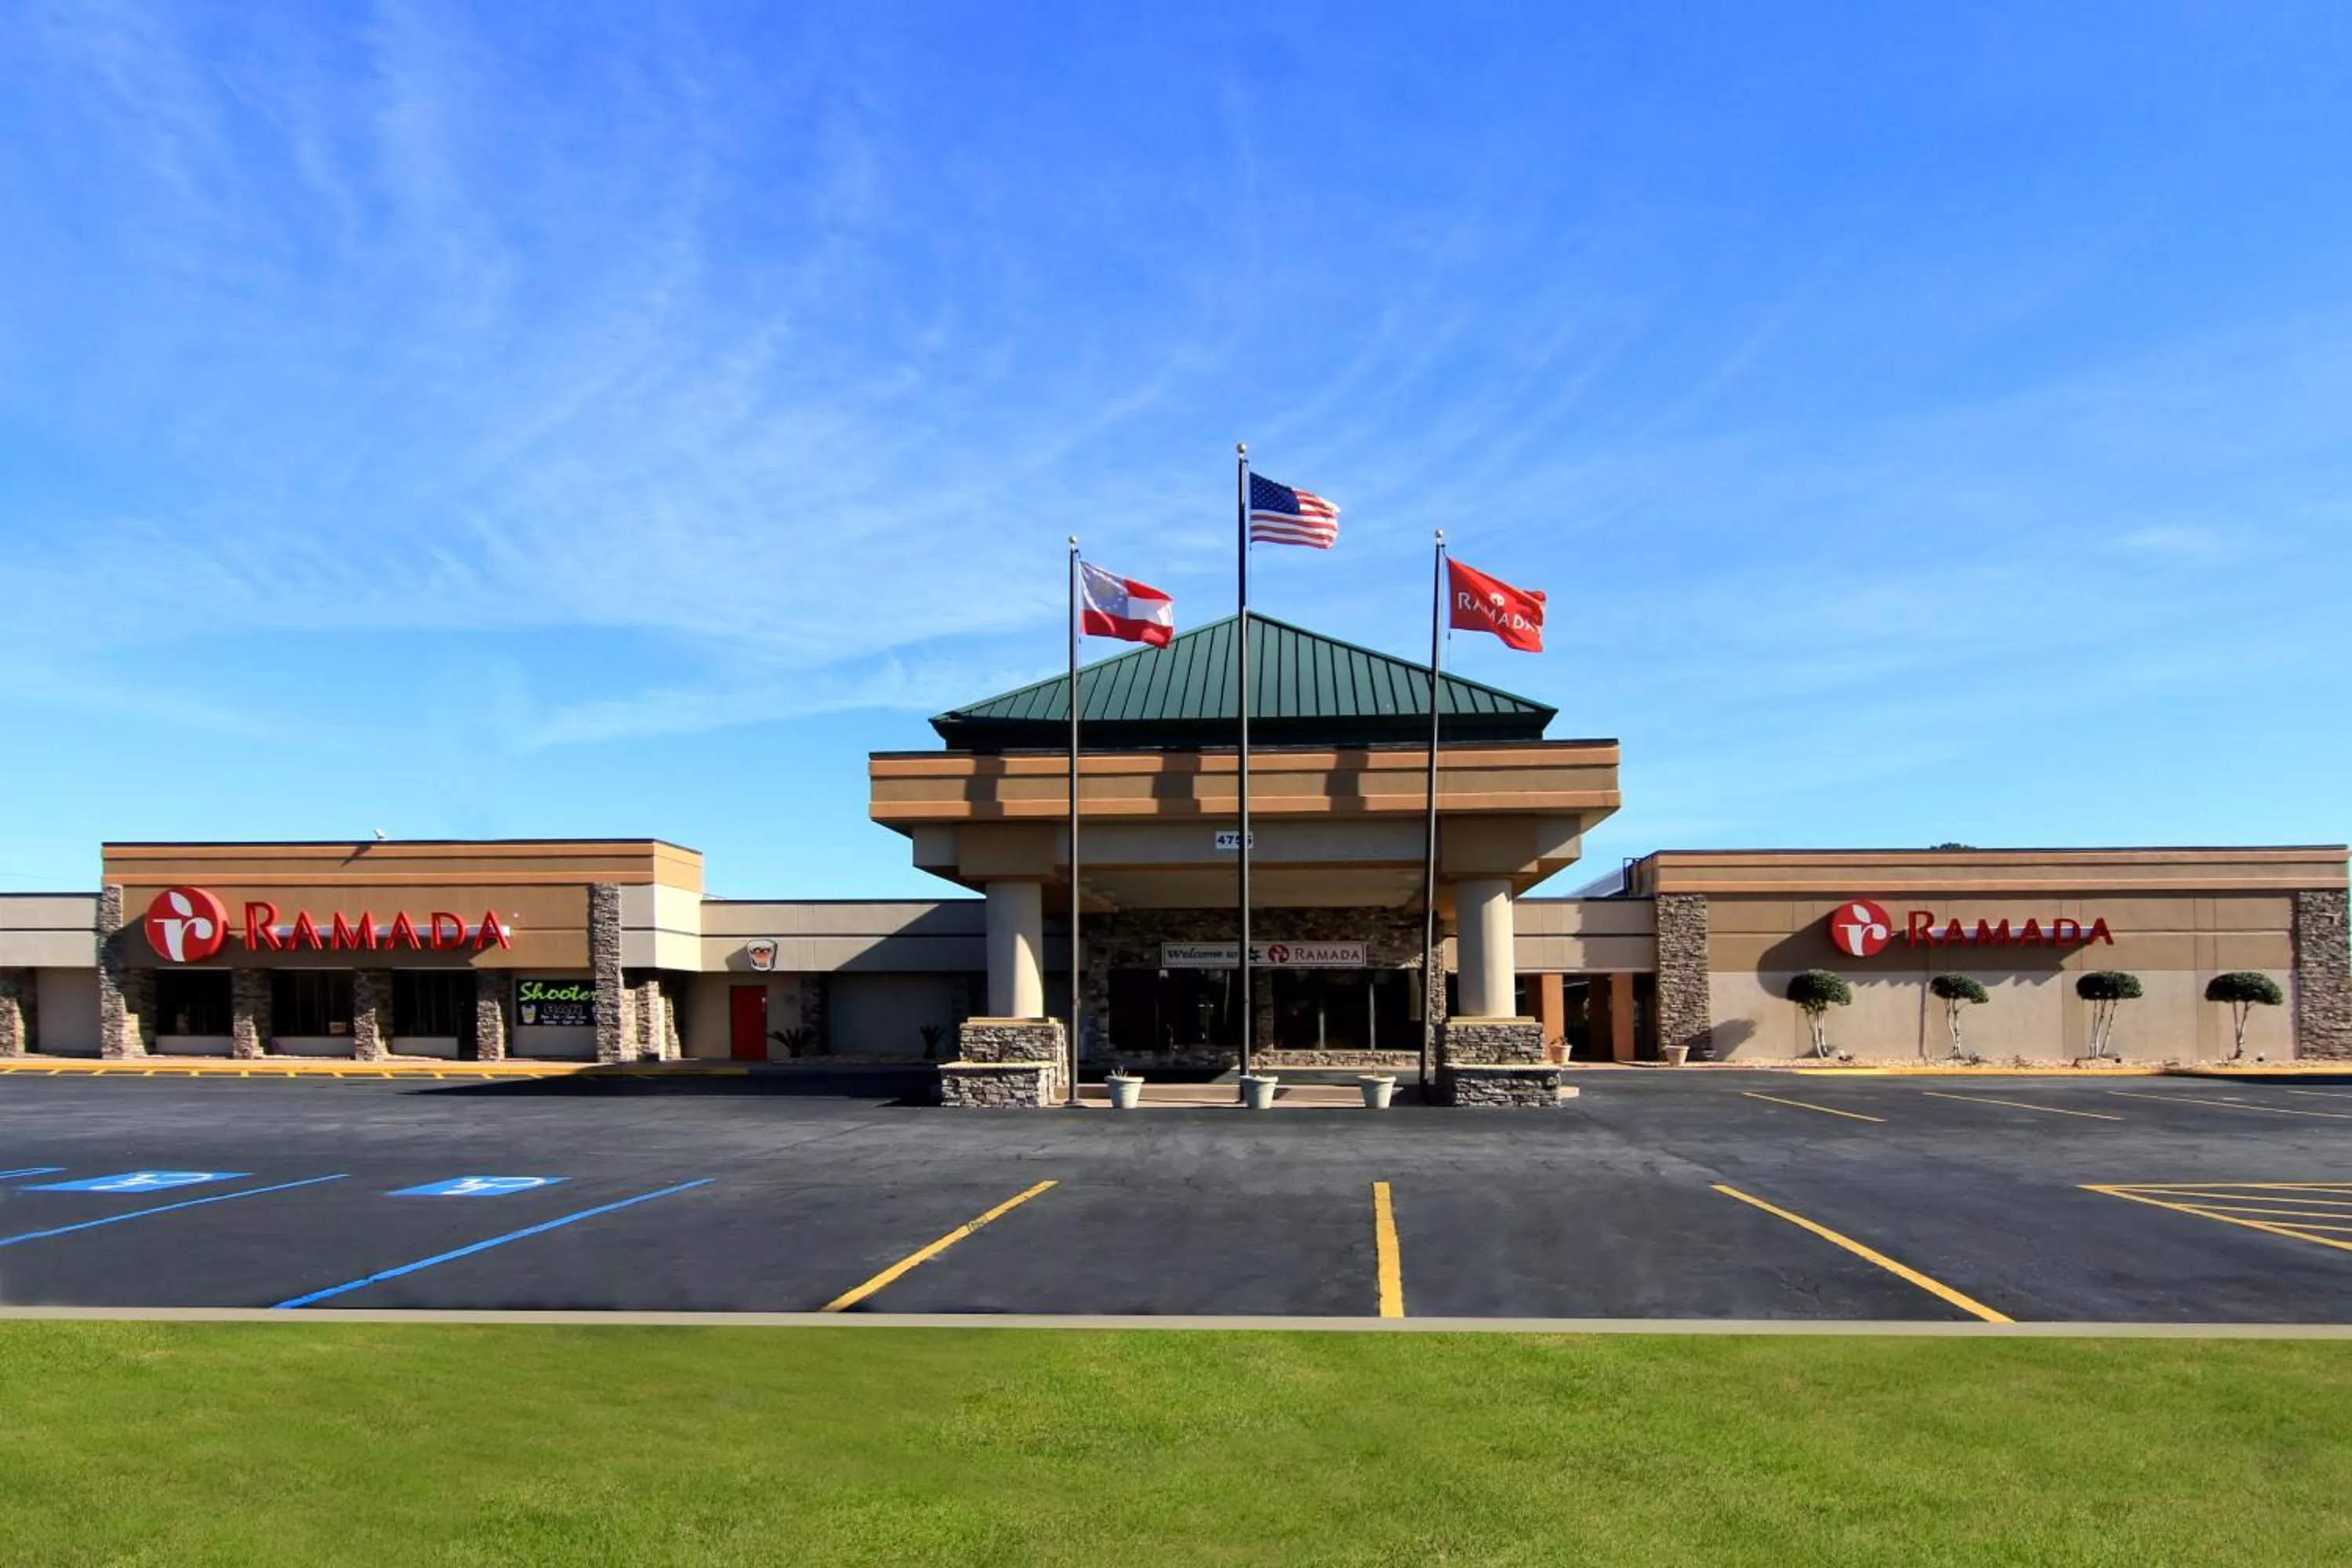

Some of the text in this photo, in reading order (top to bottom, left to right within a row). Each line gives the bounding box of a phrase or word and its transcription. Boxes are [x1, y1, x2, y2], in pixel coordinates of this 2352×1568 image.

[243, 901, 512, 950] RAMADA
[1907, 909, 2114, 948] RAMADA
[1166, 946, 1360, 960] Welcome to RAMADA
